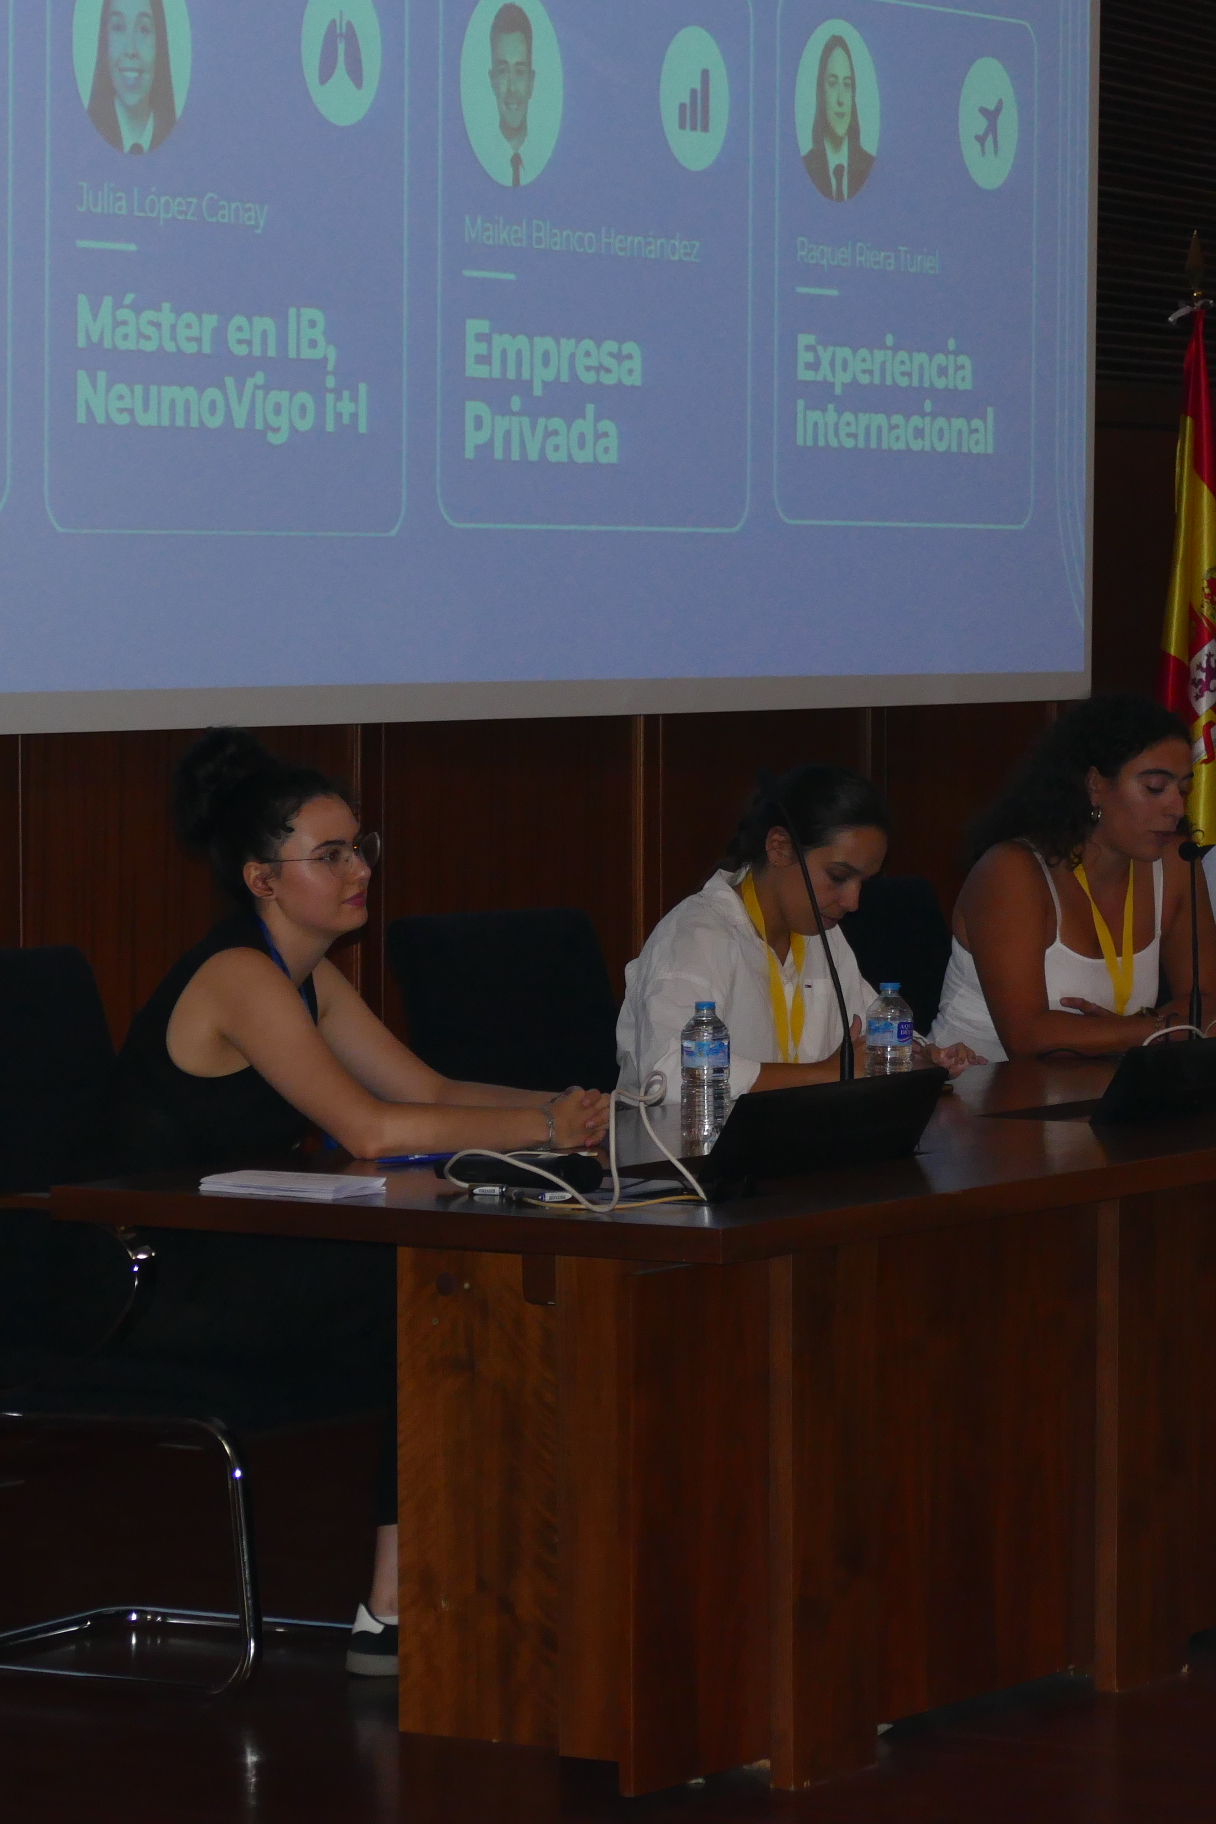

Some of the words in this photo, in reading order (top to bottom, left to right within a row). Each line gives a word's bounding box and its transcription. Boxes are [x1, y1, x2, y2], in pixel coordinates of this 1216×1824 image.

[77, 181, 127, 215] Julia
[133, 186, 197, 224] López
[202, 192, 267, 233] Canay
[464, 215, 527, 247] Maikel
[532, 219, 596, 254] Blanco
[601, 226, 701, 262] Hernández
[796, 236, 852, 270] Raquel
[856, 241, 895, 270] Riera
[897, 245, 940, 275] Turiel
[77, 292, 218, 353] Máster
[228, 315, 276, 356] en
[288, 307, 336, 371] IB,
[465, 318, 642, 396] Empresa
[797, 334, 973, 394] Experiencia
[77, 369, 316, 445] NeumoVigo
[464, 396, 619, 463] Privada
[797, 399, 995, 455] Internacional
